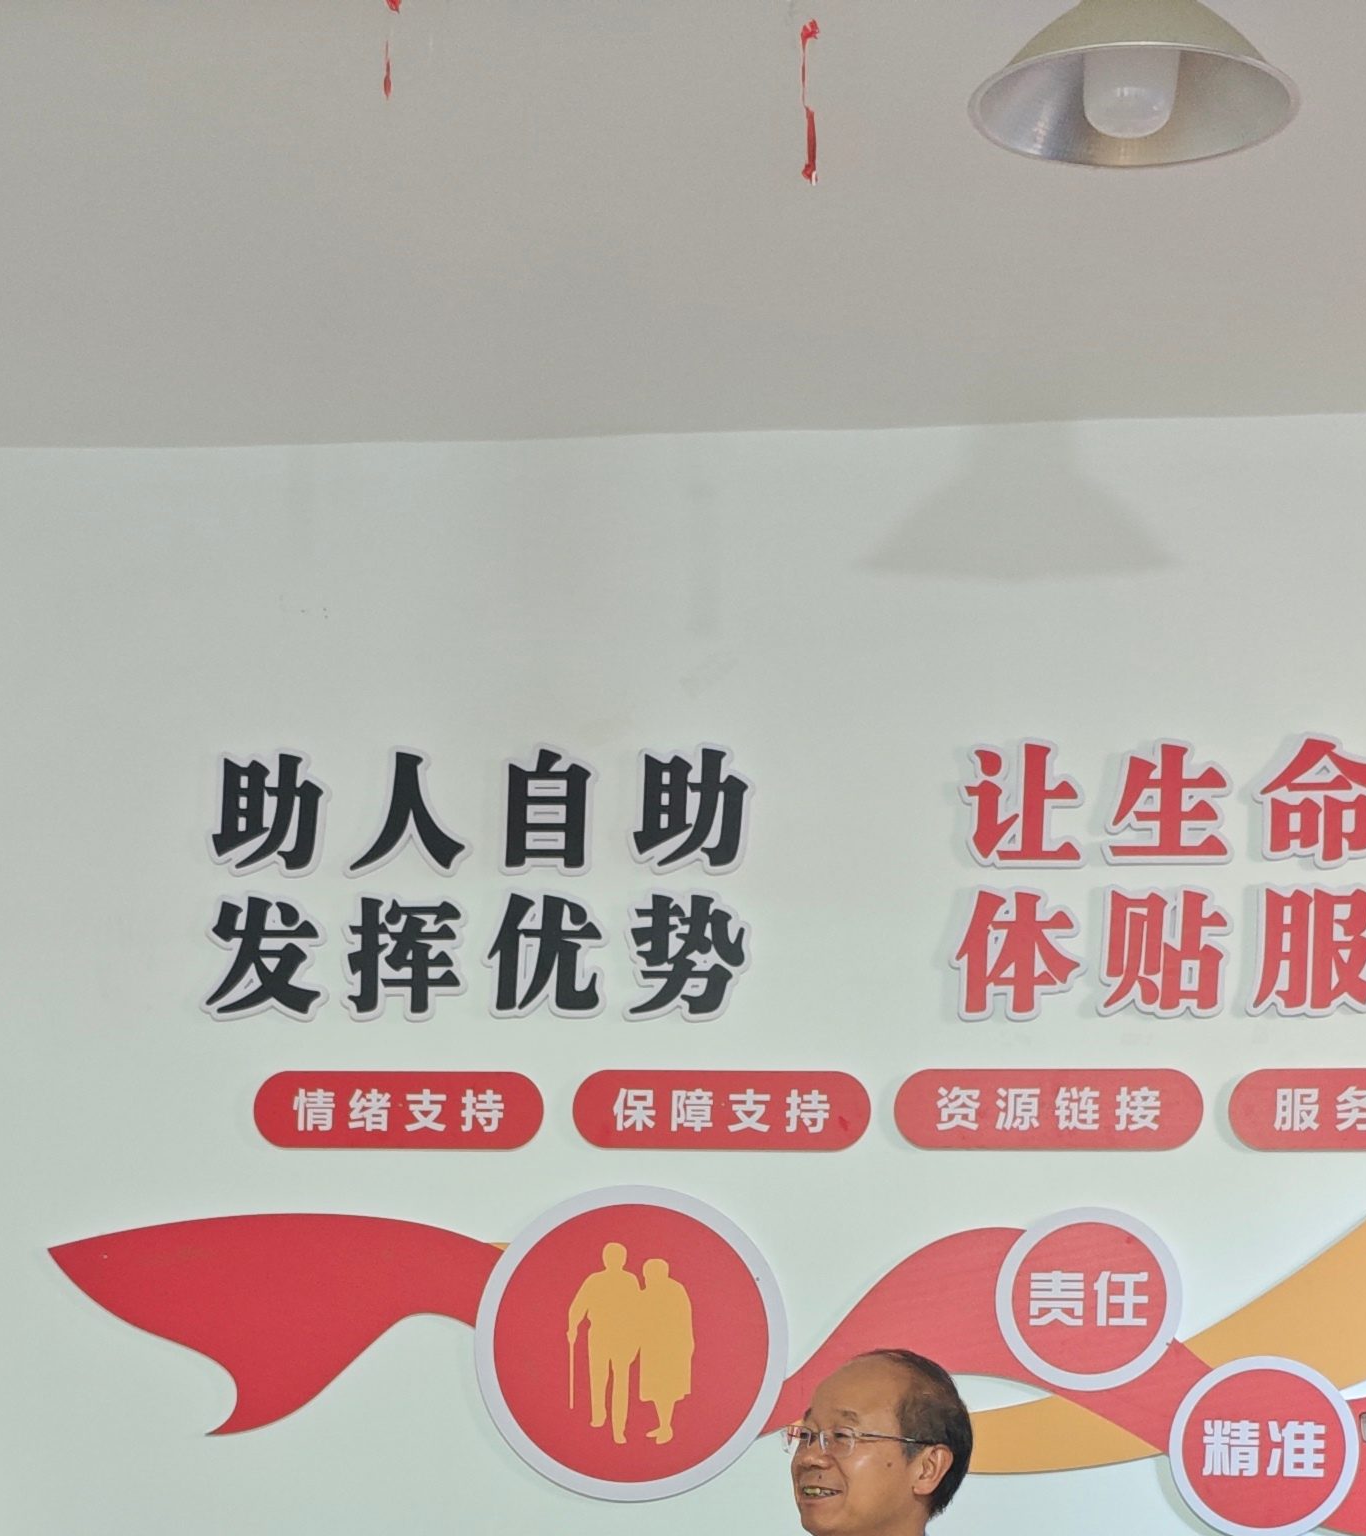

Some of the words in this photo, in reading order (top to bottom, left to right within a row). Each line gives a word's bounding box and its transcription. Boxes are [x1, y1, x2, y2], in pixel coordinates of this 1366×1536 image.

[211, 747, 749, 871] 助人自助
[205, 892, 745, 1015] 发挥优势
[293, 1088, 505, 1132] 情绪支持
[613, 1087, 831, 1133] 保障支持
[936, 1086, 1162, 1132] 资源链接
[1028, 1270, 1149, 1327] 责任
[1202, 1419, 1326, 1478] 精准
